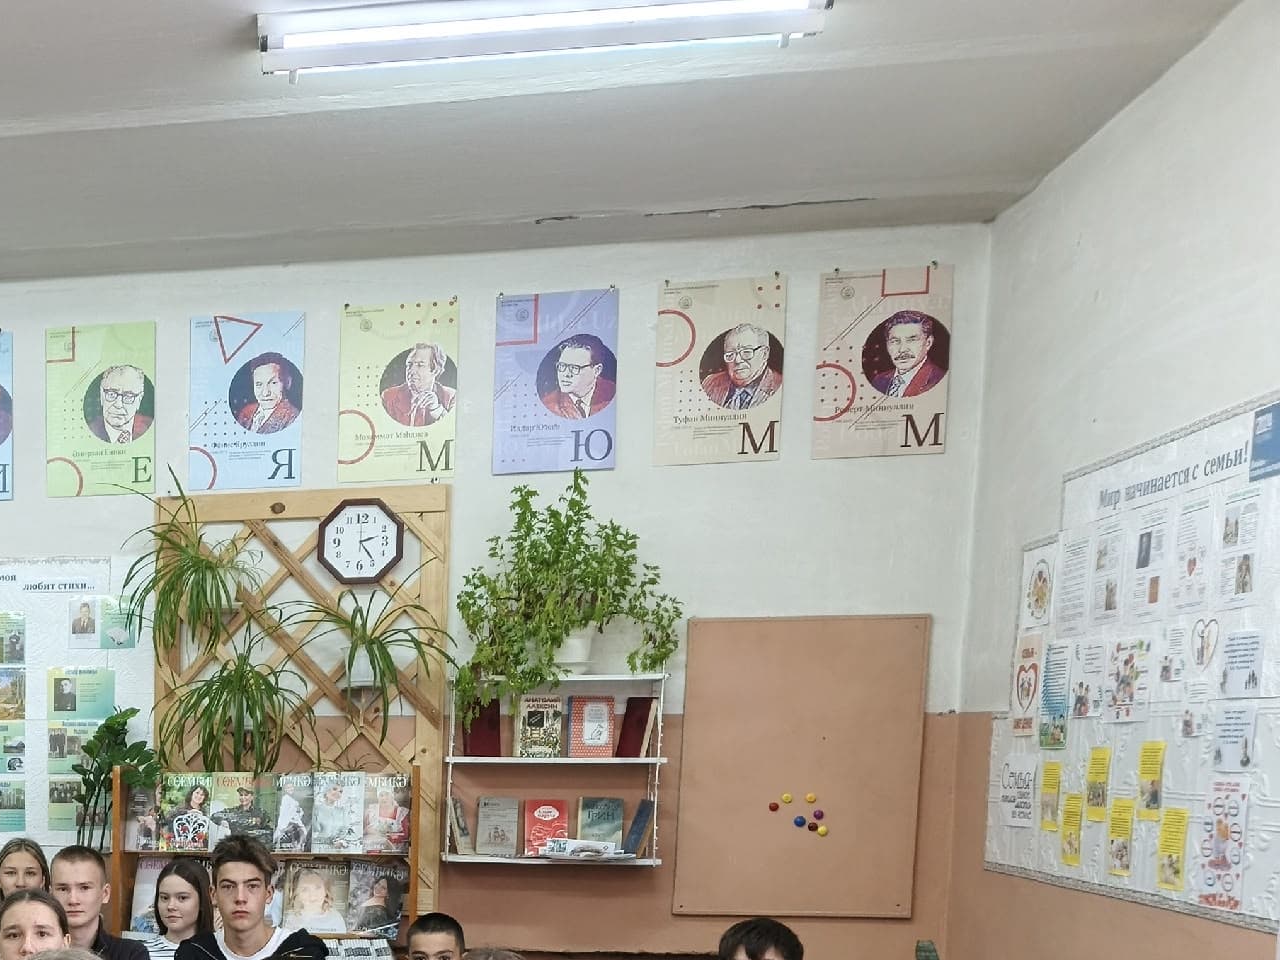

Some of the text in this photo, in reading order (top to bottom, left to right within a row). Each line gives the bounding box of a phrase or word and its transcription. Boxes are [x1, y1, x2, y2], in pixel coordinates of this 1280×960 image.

[900, 412, 944, 447] М
[737, 420, 779, 454] М
[570, 428, 612, 462] Ю
[416, 439, 454, 472] М
[267, 449, 296, 479] Я
[131, 456, 152, 484] Е
[1098, 440, 1249, 510] Мир начинается с семьи!
[356, 513, 369, 524] 12
[373, 516, 377, 524] 1
[381, 525, 387, 533] 2
[333, 538, 341, 548] 9
[381, 536, 389, 546] 3
[356, 560, 363, 571] 6
[370, 560, 375, 568] 5
[23, 581, 56, 591] любит
